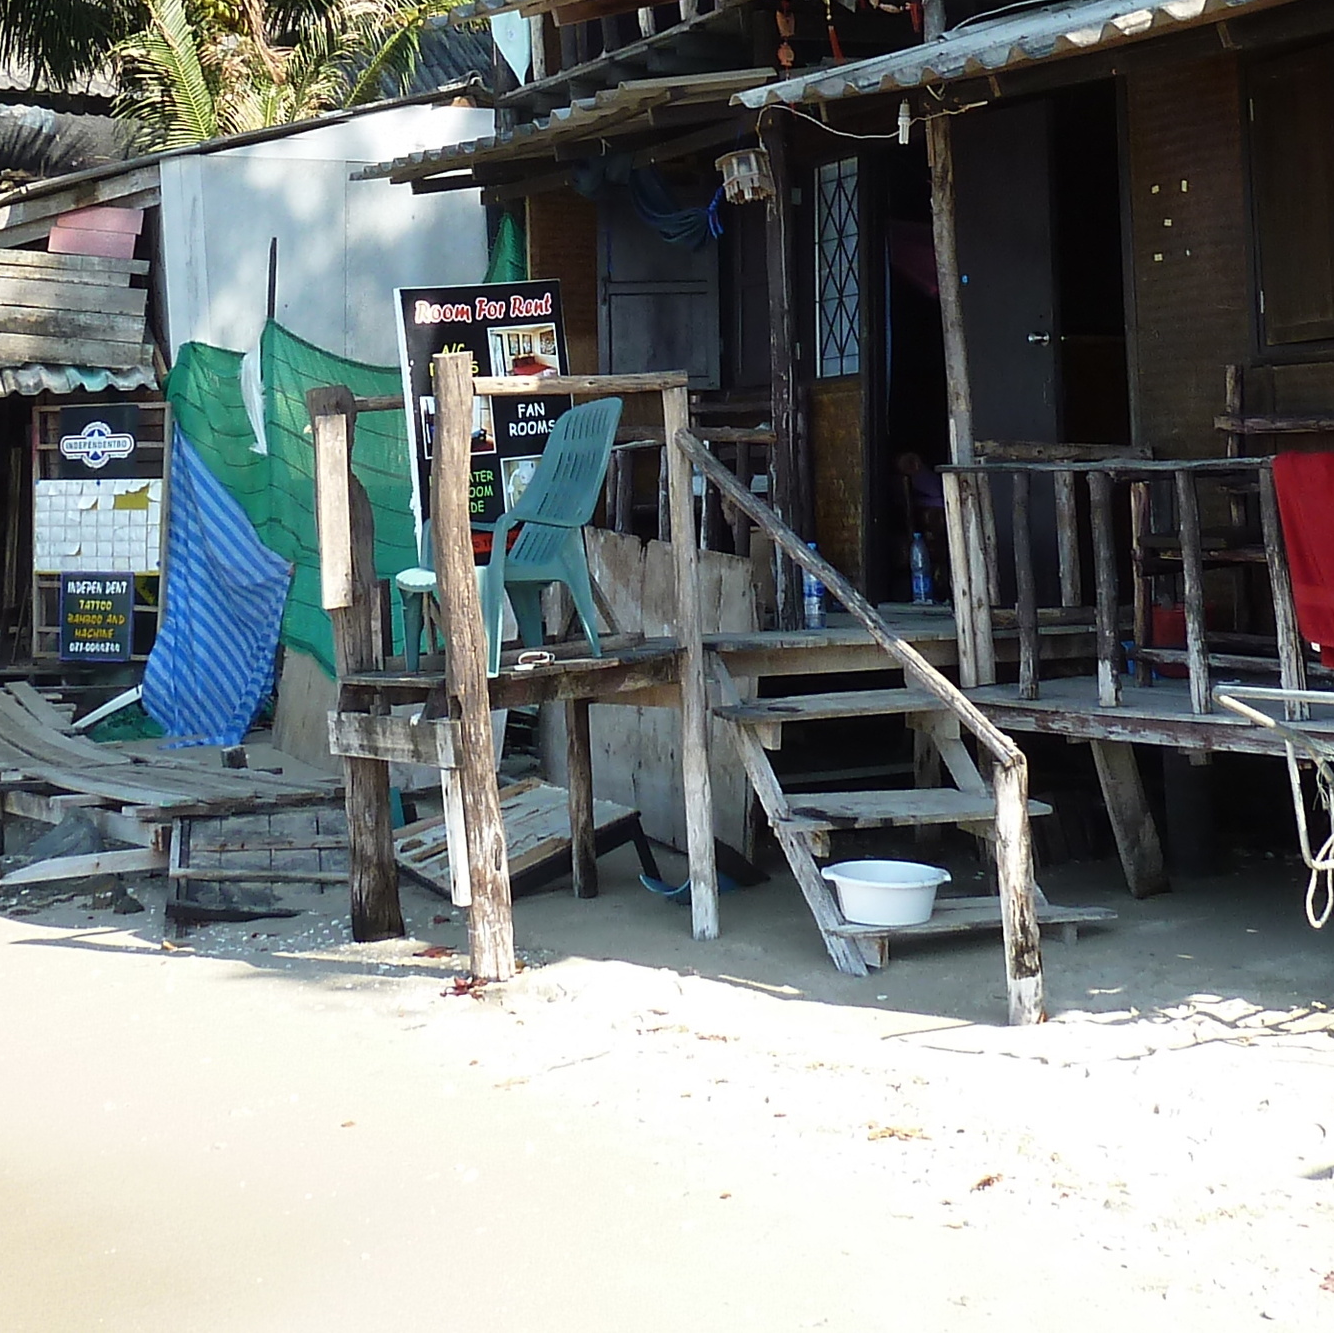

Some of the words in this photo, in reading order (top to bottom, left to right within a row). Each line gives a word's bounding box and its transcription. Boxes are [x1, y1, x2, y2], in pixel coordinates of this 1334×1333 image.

[414, 299, 471, 324] Room
[476, 297, 505, 321] For
[510, 292, 552, 317] Rent
[517, 402, 545, 418] FAN
[508, 419, 555, 436] ROOMS
[79, 599, 112, 610] TATTOO
[68, 613, 103, 624] BAMBOO
[106, 614, 125, 624] AND
[75, 628, 114, 638] MACHINE
